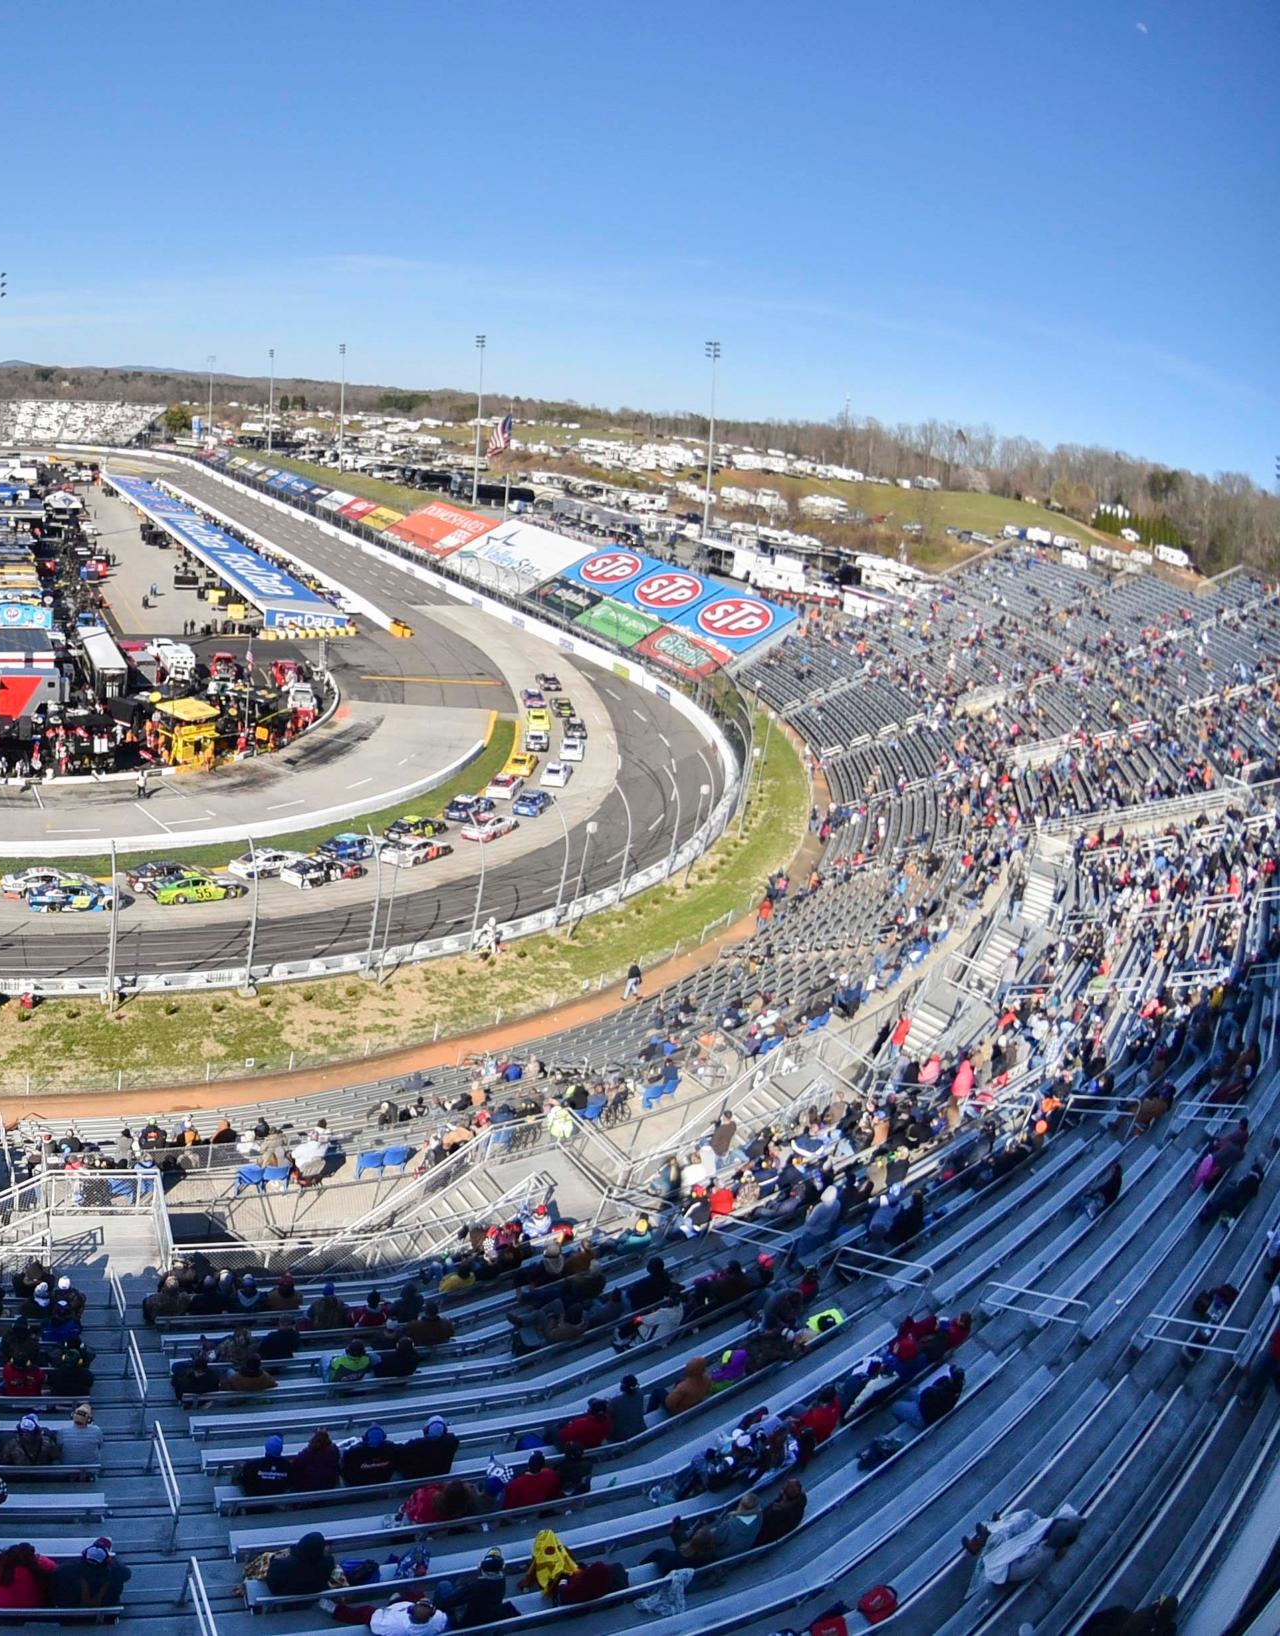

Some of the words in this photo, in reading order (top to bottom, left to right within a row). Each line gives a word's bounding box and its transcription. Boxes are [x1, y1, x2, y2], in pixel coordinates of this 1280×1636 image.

[483, 547, 517, 569] Valley
[516, 558, 542, 576] Star
[586, 556, 634, 578] STP
[639, 576, 695, 602] STP
[275, 613, 303, 627] First
[304, 614, 335, 627] Data
[703, 602, 762, 631] STP
[195, 887, 212, 899] 55
